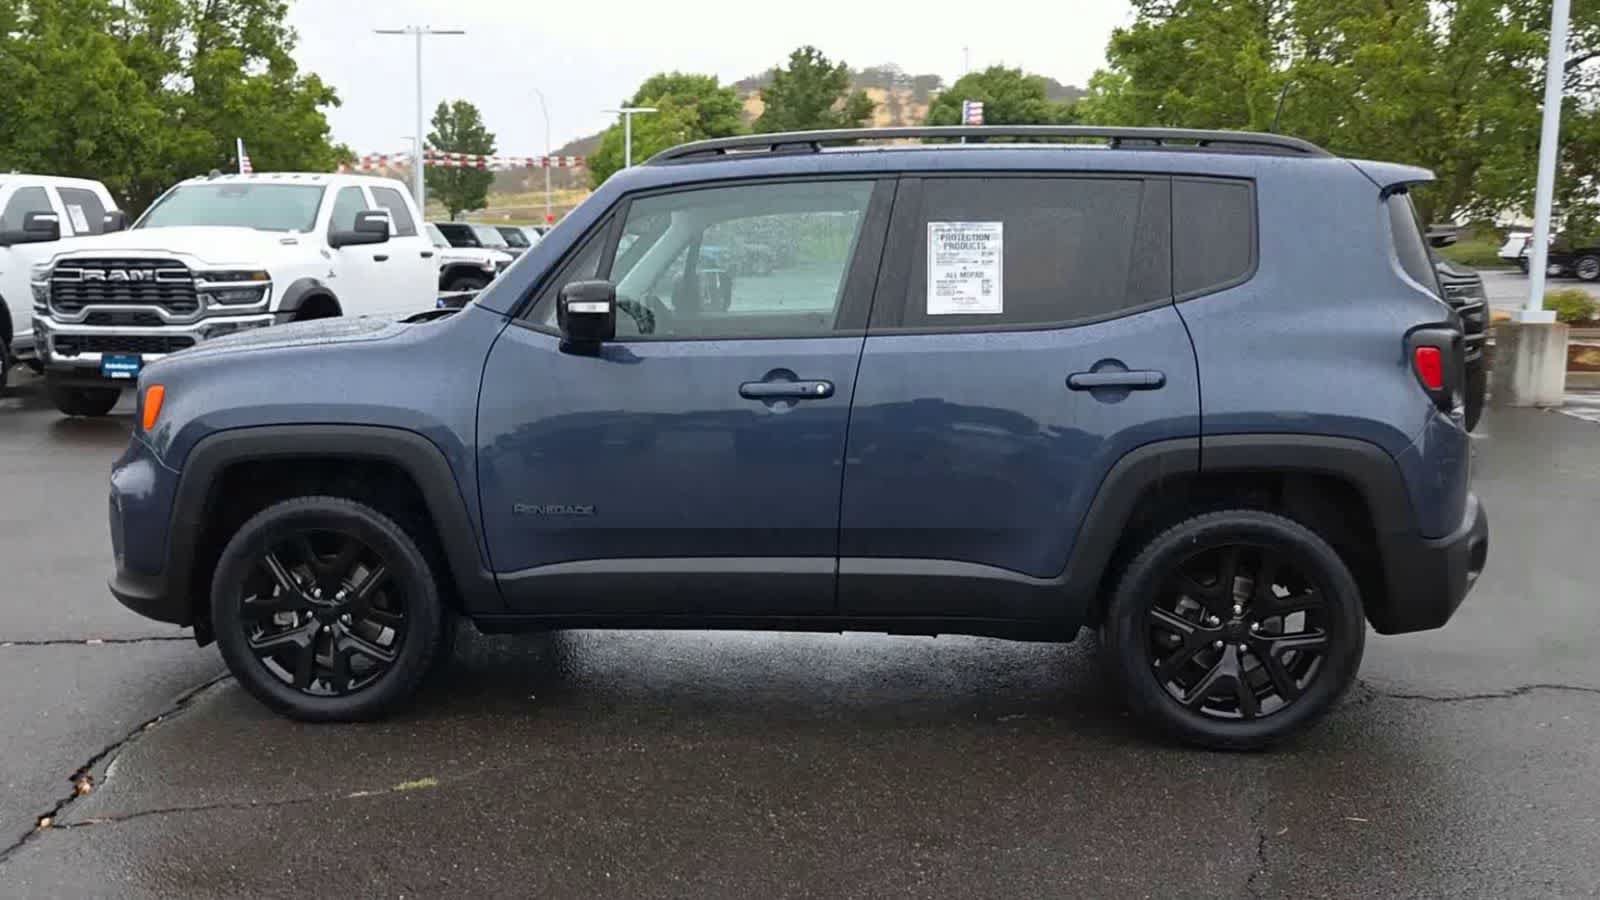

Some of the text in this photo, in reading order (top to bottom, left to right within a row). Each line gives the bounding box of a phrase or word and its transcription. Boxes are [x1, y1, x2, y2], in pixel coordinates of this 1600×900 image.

[940, 233, 990, 241] PROTECTION
[943, 242, 987, 250] PRODUCTS
[83, 269, 154, 280] RAM
